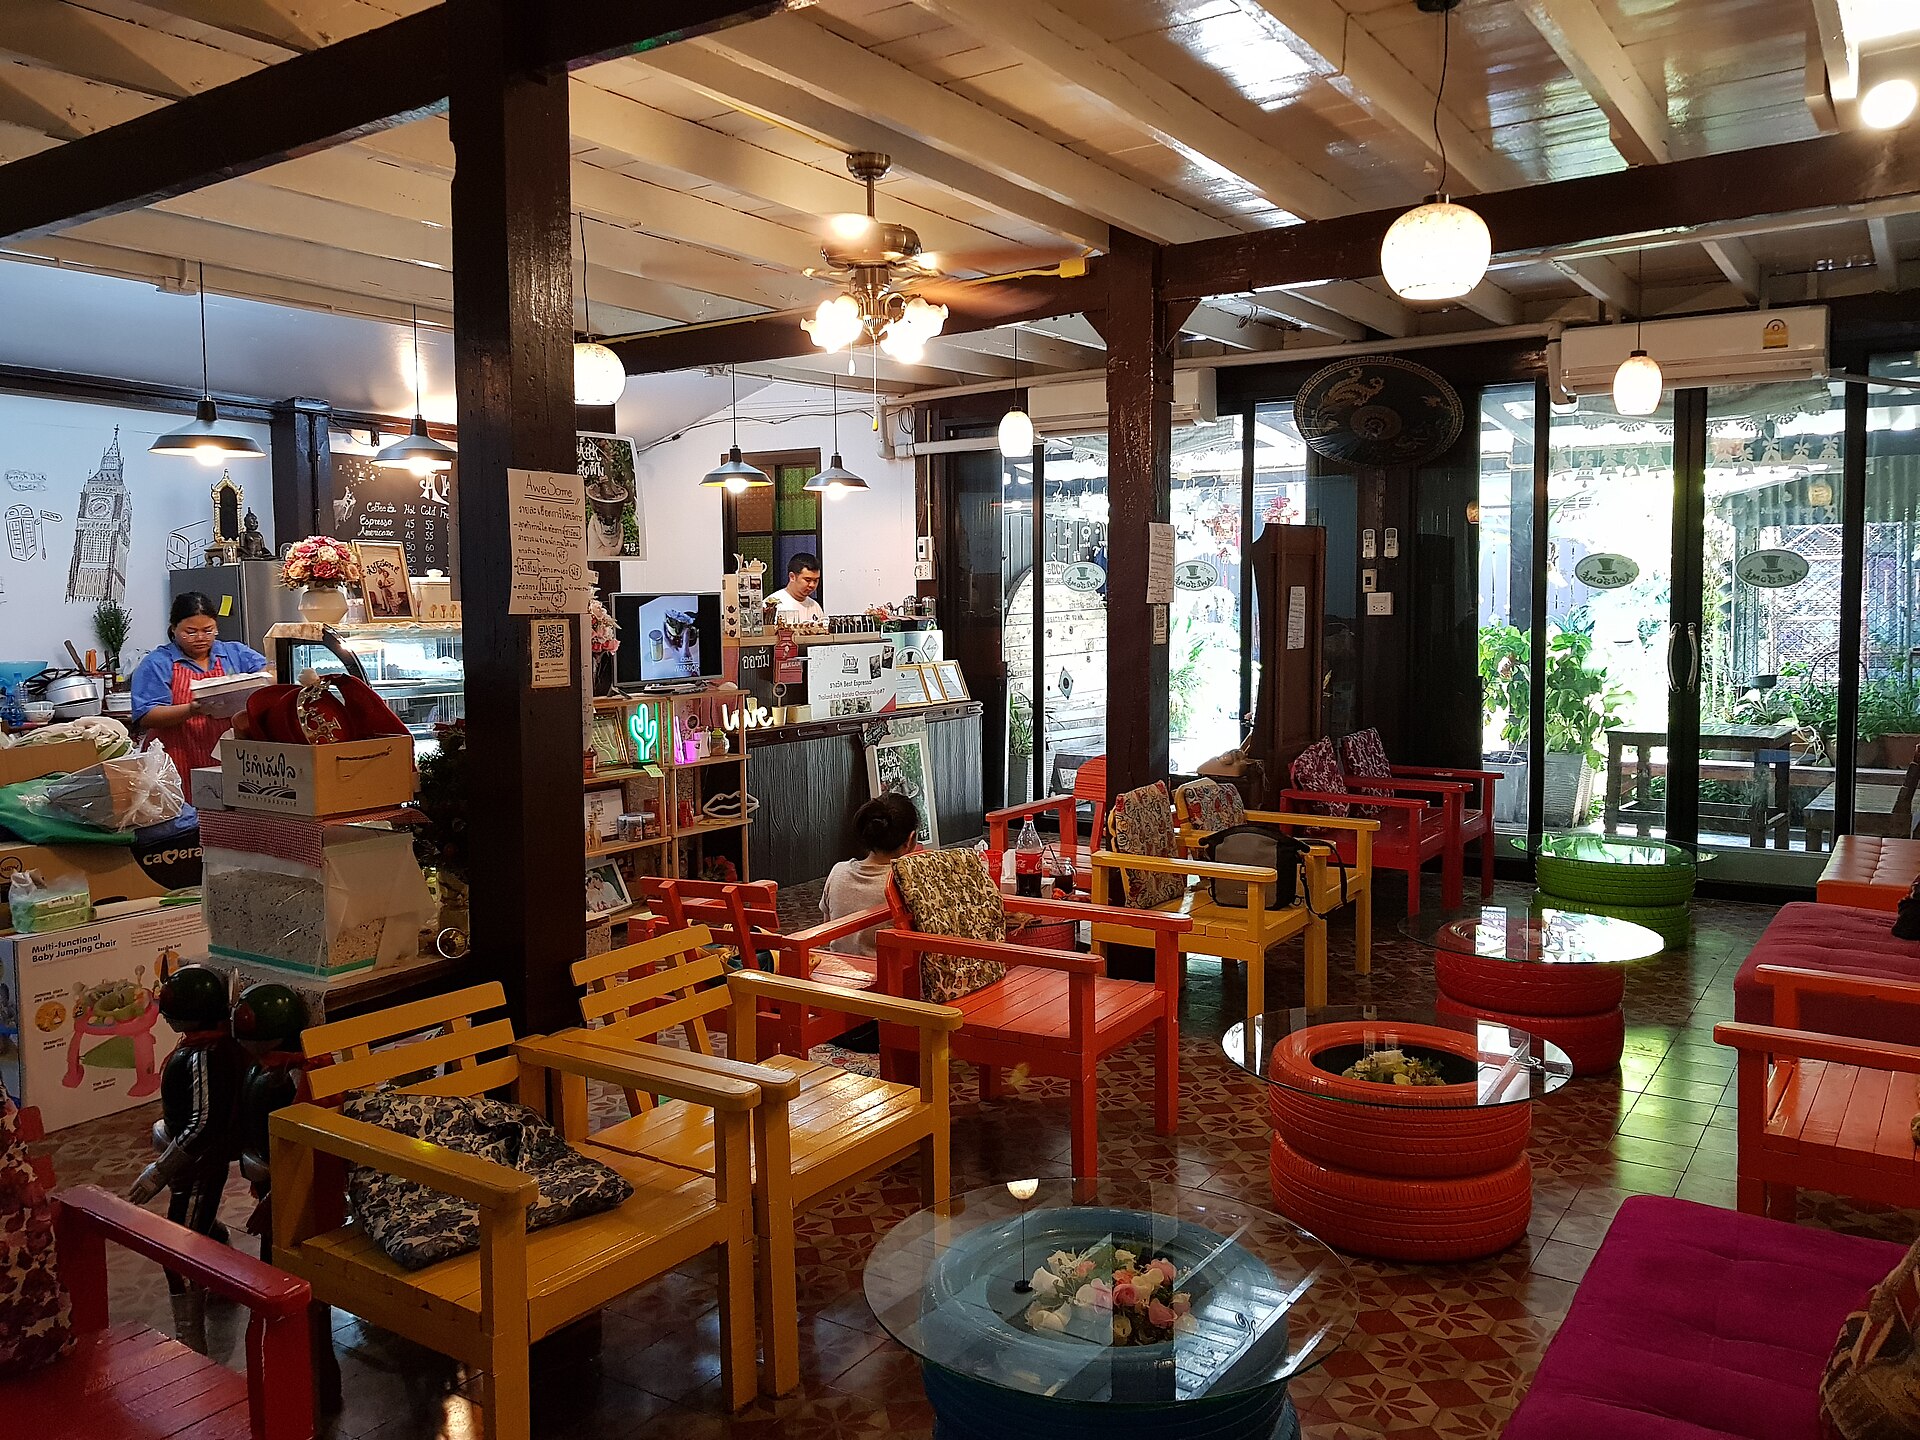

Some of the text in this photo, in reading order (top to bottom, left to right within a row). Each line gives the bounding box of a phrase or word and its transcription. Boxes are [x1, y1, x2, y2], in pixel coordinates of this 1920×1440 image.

[366, 501, 387, 513] Coffee
[420, 504, 437, 517] Cold
[359, 513, 393, 526] Espresso
[404, 519, 415, 529] 45
[425, 520, 435, 531] 55
[404, 530, 415, 540] 45
[424, 530, 434, 541] 55
[405, 542, 435, 552] 50 60
[406, 553, 436, 563] 50 60
[31, 932, 101, 954] Multi-functional
[32, 938, 117, 963] Baby Jumping Chair
